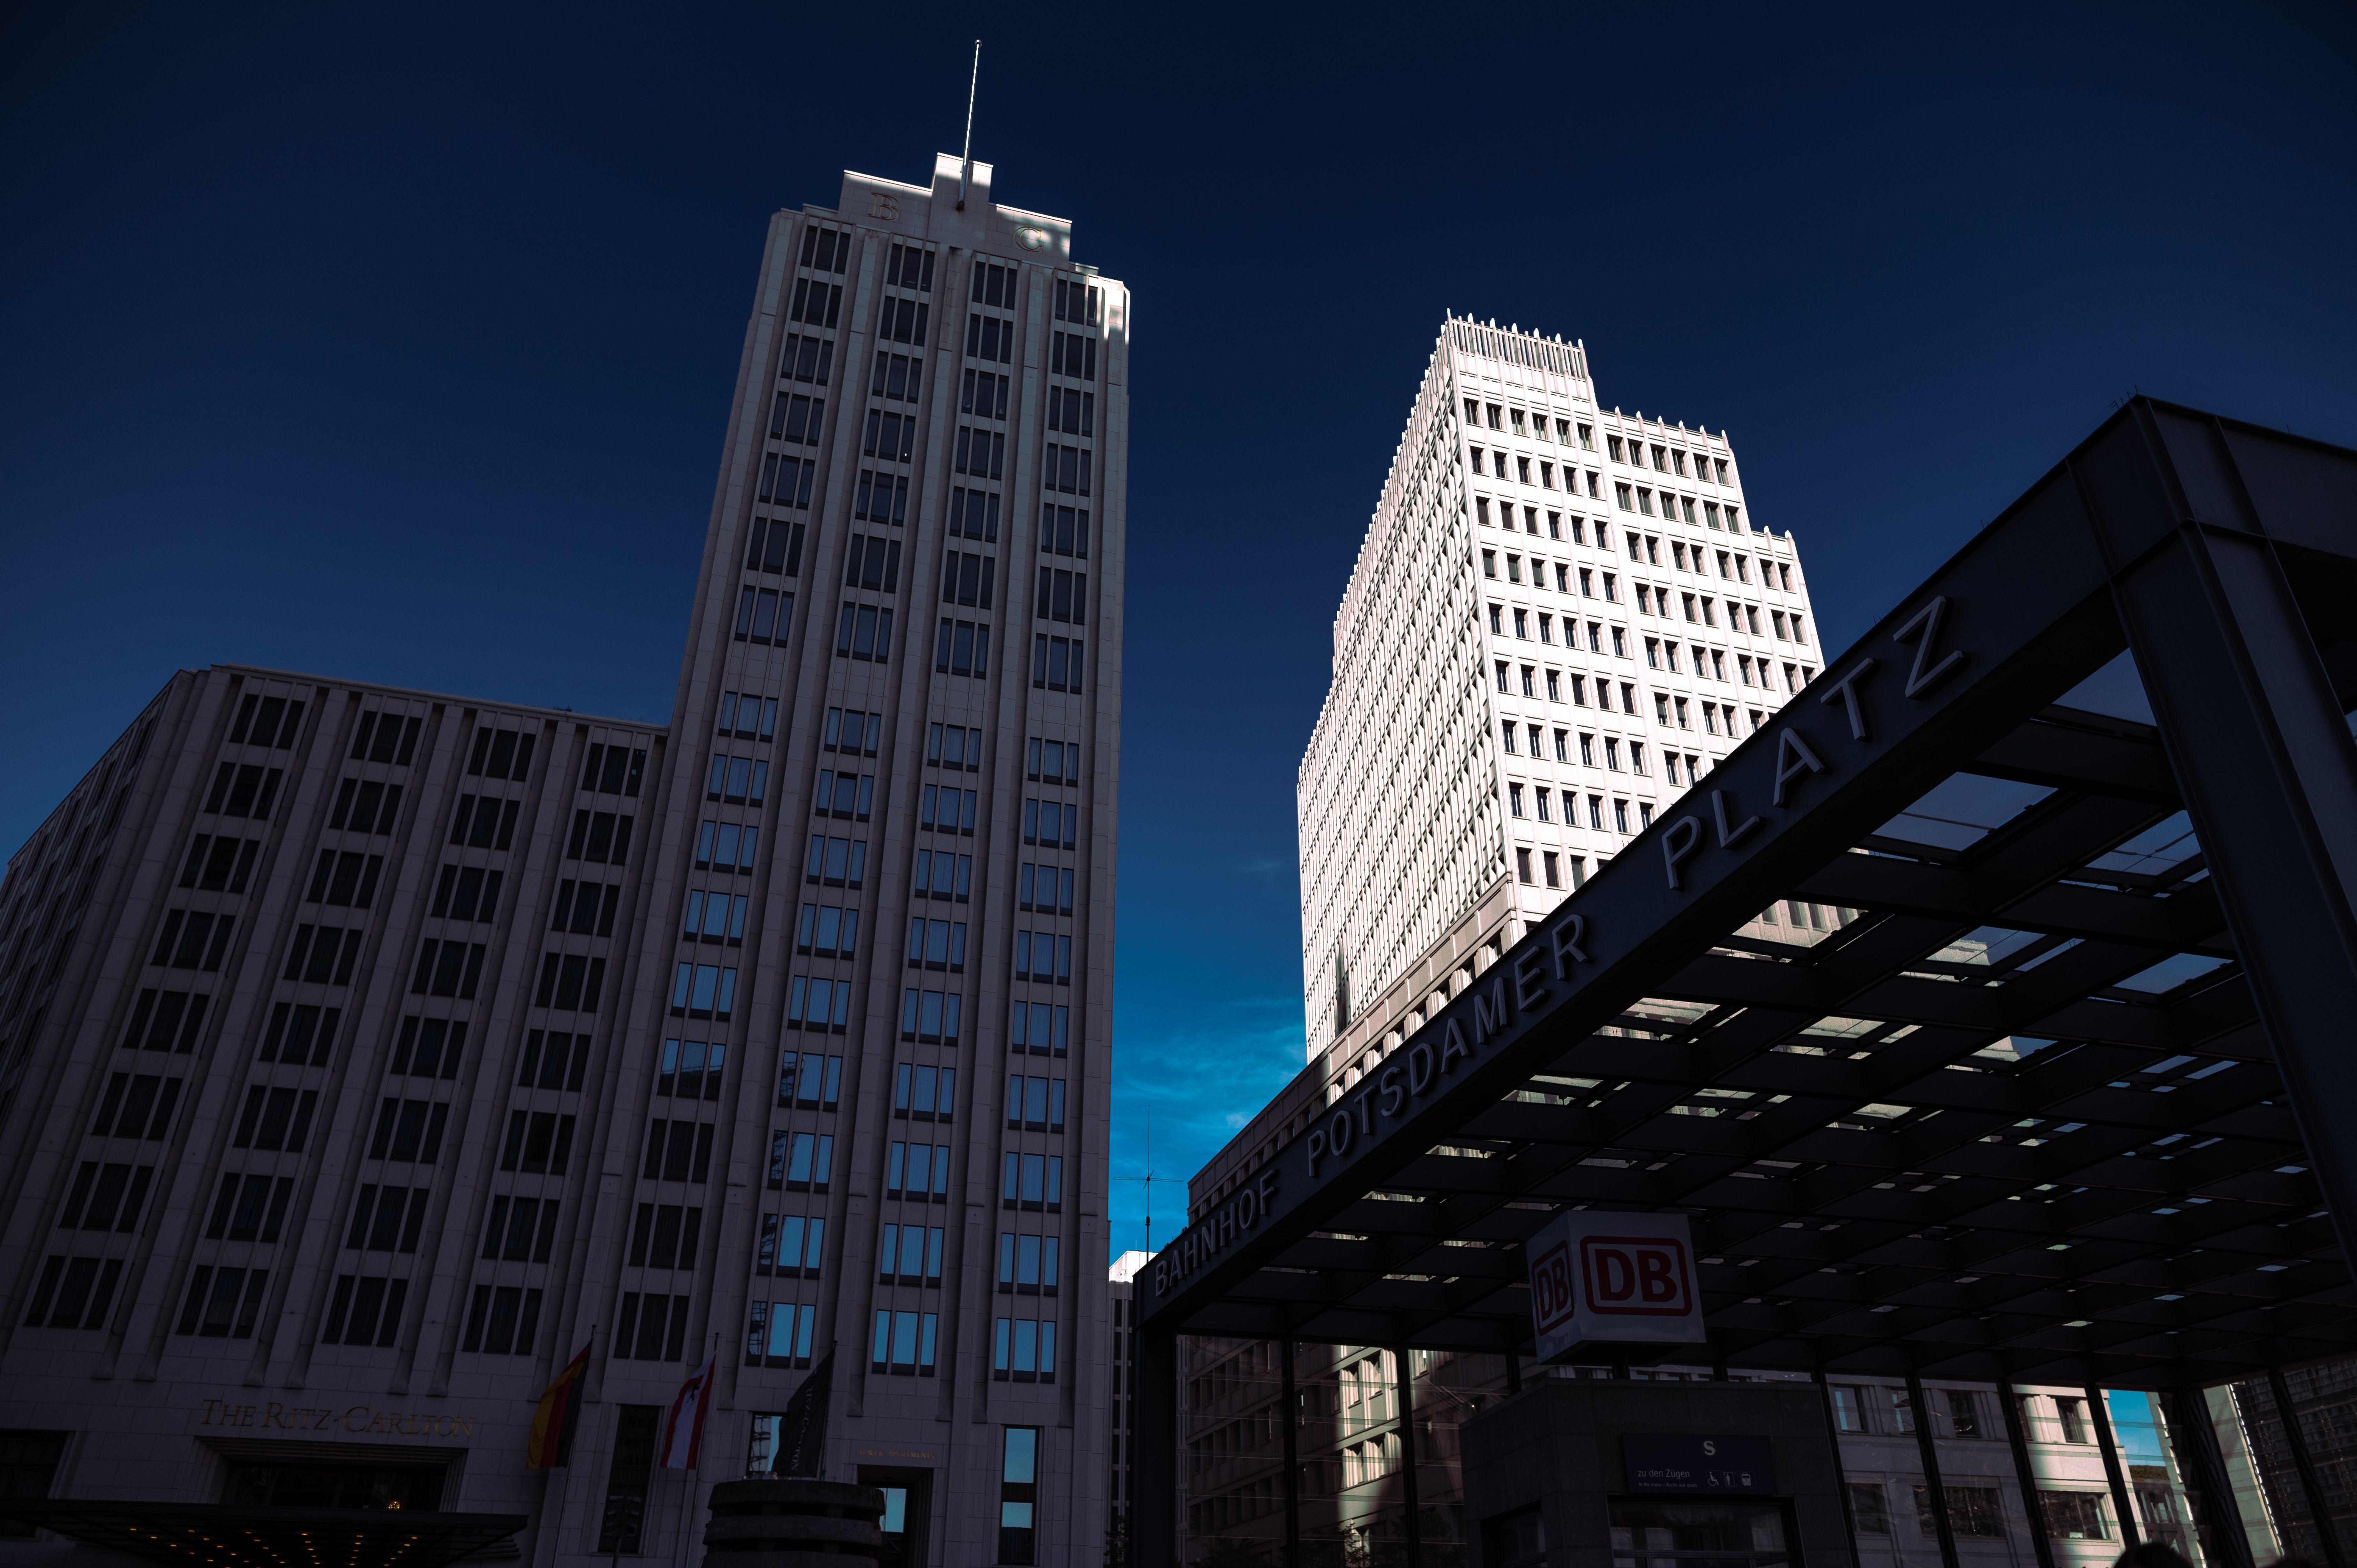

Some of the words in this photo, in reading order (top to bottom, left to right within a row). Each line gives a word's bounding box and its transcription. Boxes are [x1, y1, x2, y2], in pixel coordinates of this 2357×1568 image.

[867, 192, 899, 220] B
[1014, 226, 1042, 253] C
[1156, 1169, 1278, 1297] BAHNHOF
[1308, 914, 1594, 1178] POTSDAMER
[1661, 595, 1971, 891] PLATZ
[1537, 1257, 1568, 1322] DB
[1595, 1248, 1677, 1302] DB
[201, 1399, 256, 1426] THE
[261, 1402, 475, 1437] RITZ-CARLTON
[888, 1451, 935, 1459] APARTMENTS
[1703, 1441, 1716, 1455] S
[1649, 1469, 1664, 1477] den
[1665, 1469, 1690, 1479] Zügen
